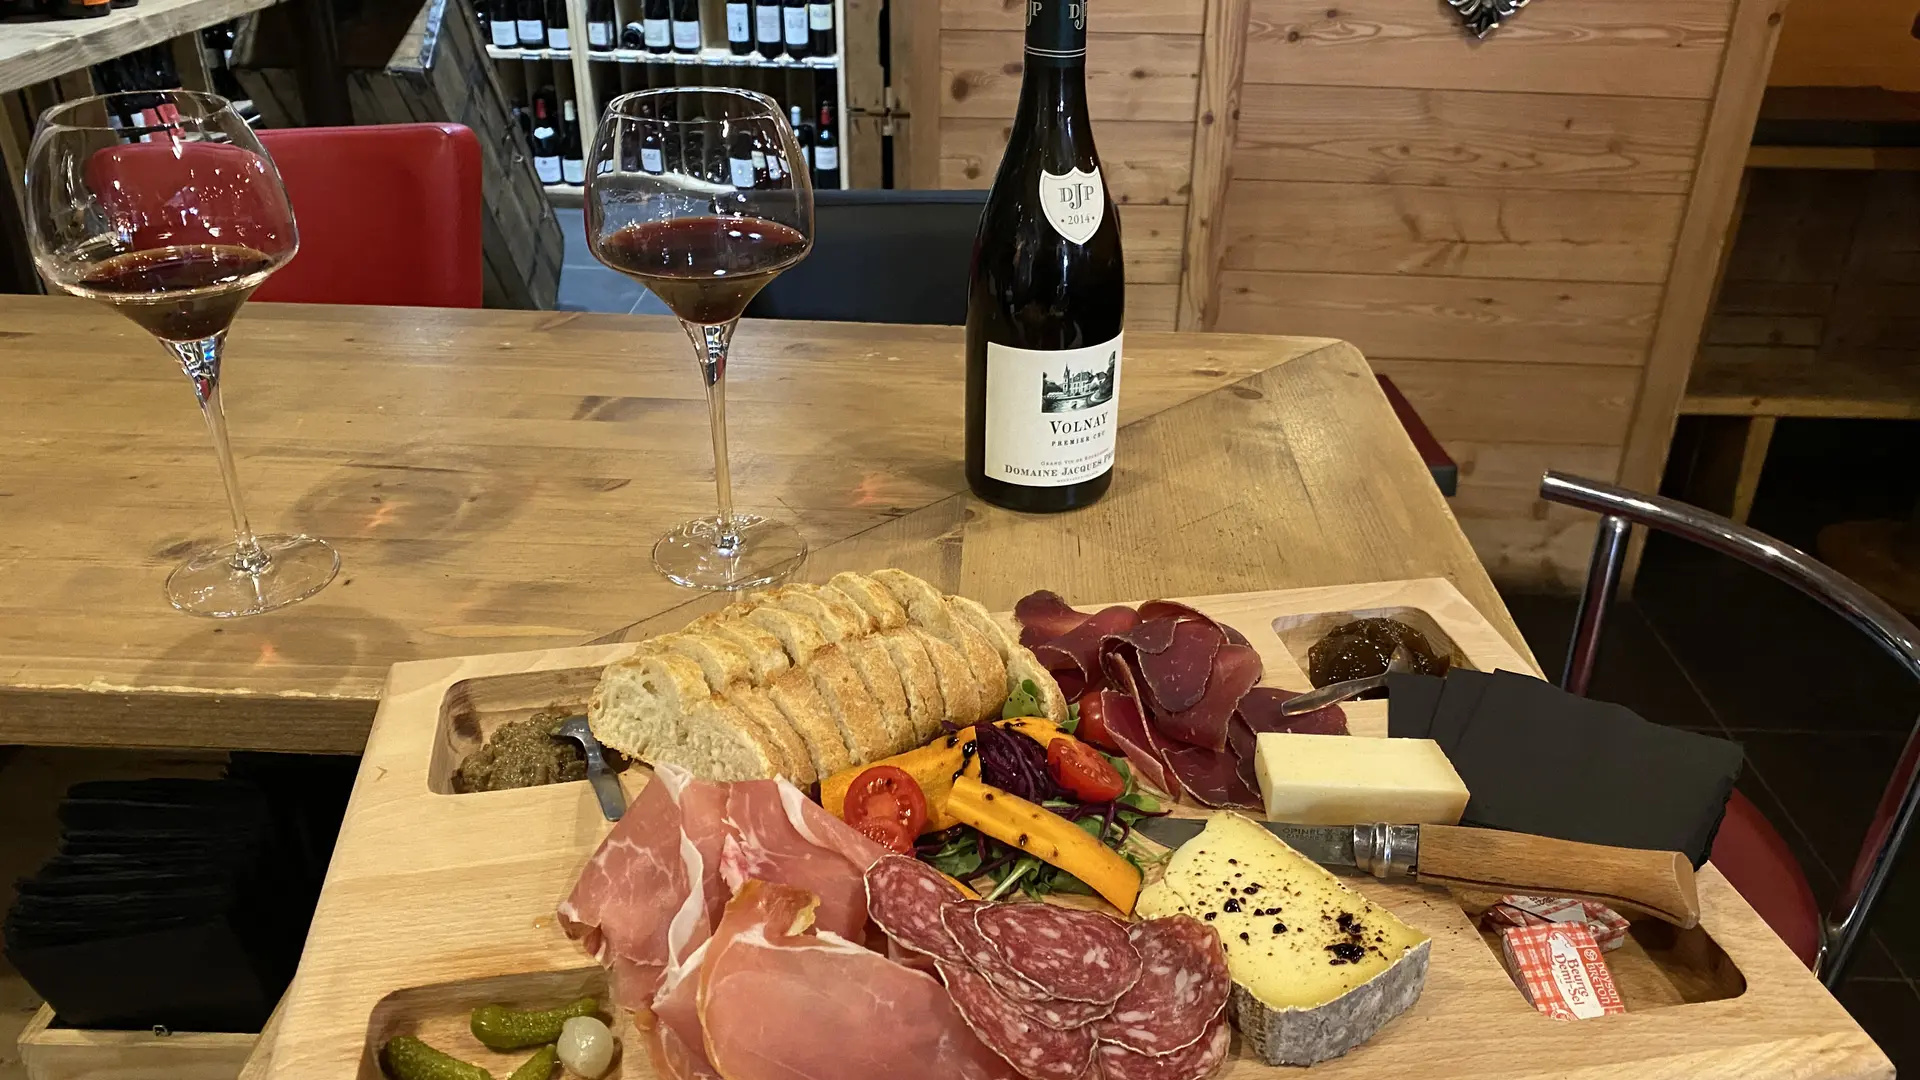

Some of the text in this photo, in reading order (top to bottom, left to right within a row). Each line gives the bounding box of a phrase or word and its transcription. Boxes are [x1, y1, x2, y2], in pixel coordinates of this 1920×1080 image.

[1058, 182, 1095, 210] DJP
[1049, 411, 1108, 434] VOLNAY
[1051, 436, 1090, 447] PREMIER
[1004, 464, 1058, 477] DOMAINE
[1061, 459, 1102, 476] JACQUES
[1554, 952, 1585, 1006] Demi-Sel
[1567, 958, 1589, 998] Beurre
[1585, 962, 1611, 1004] BRETON
